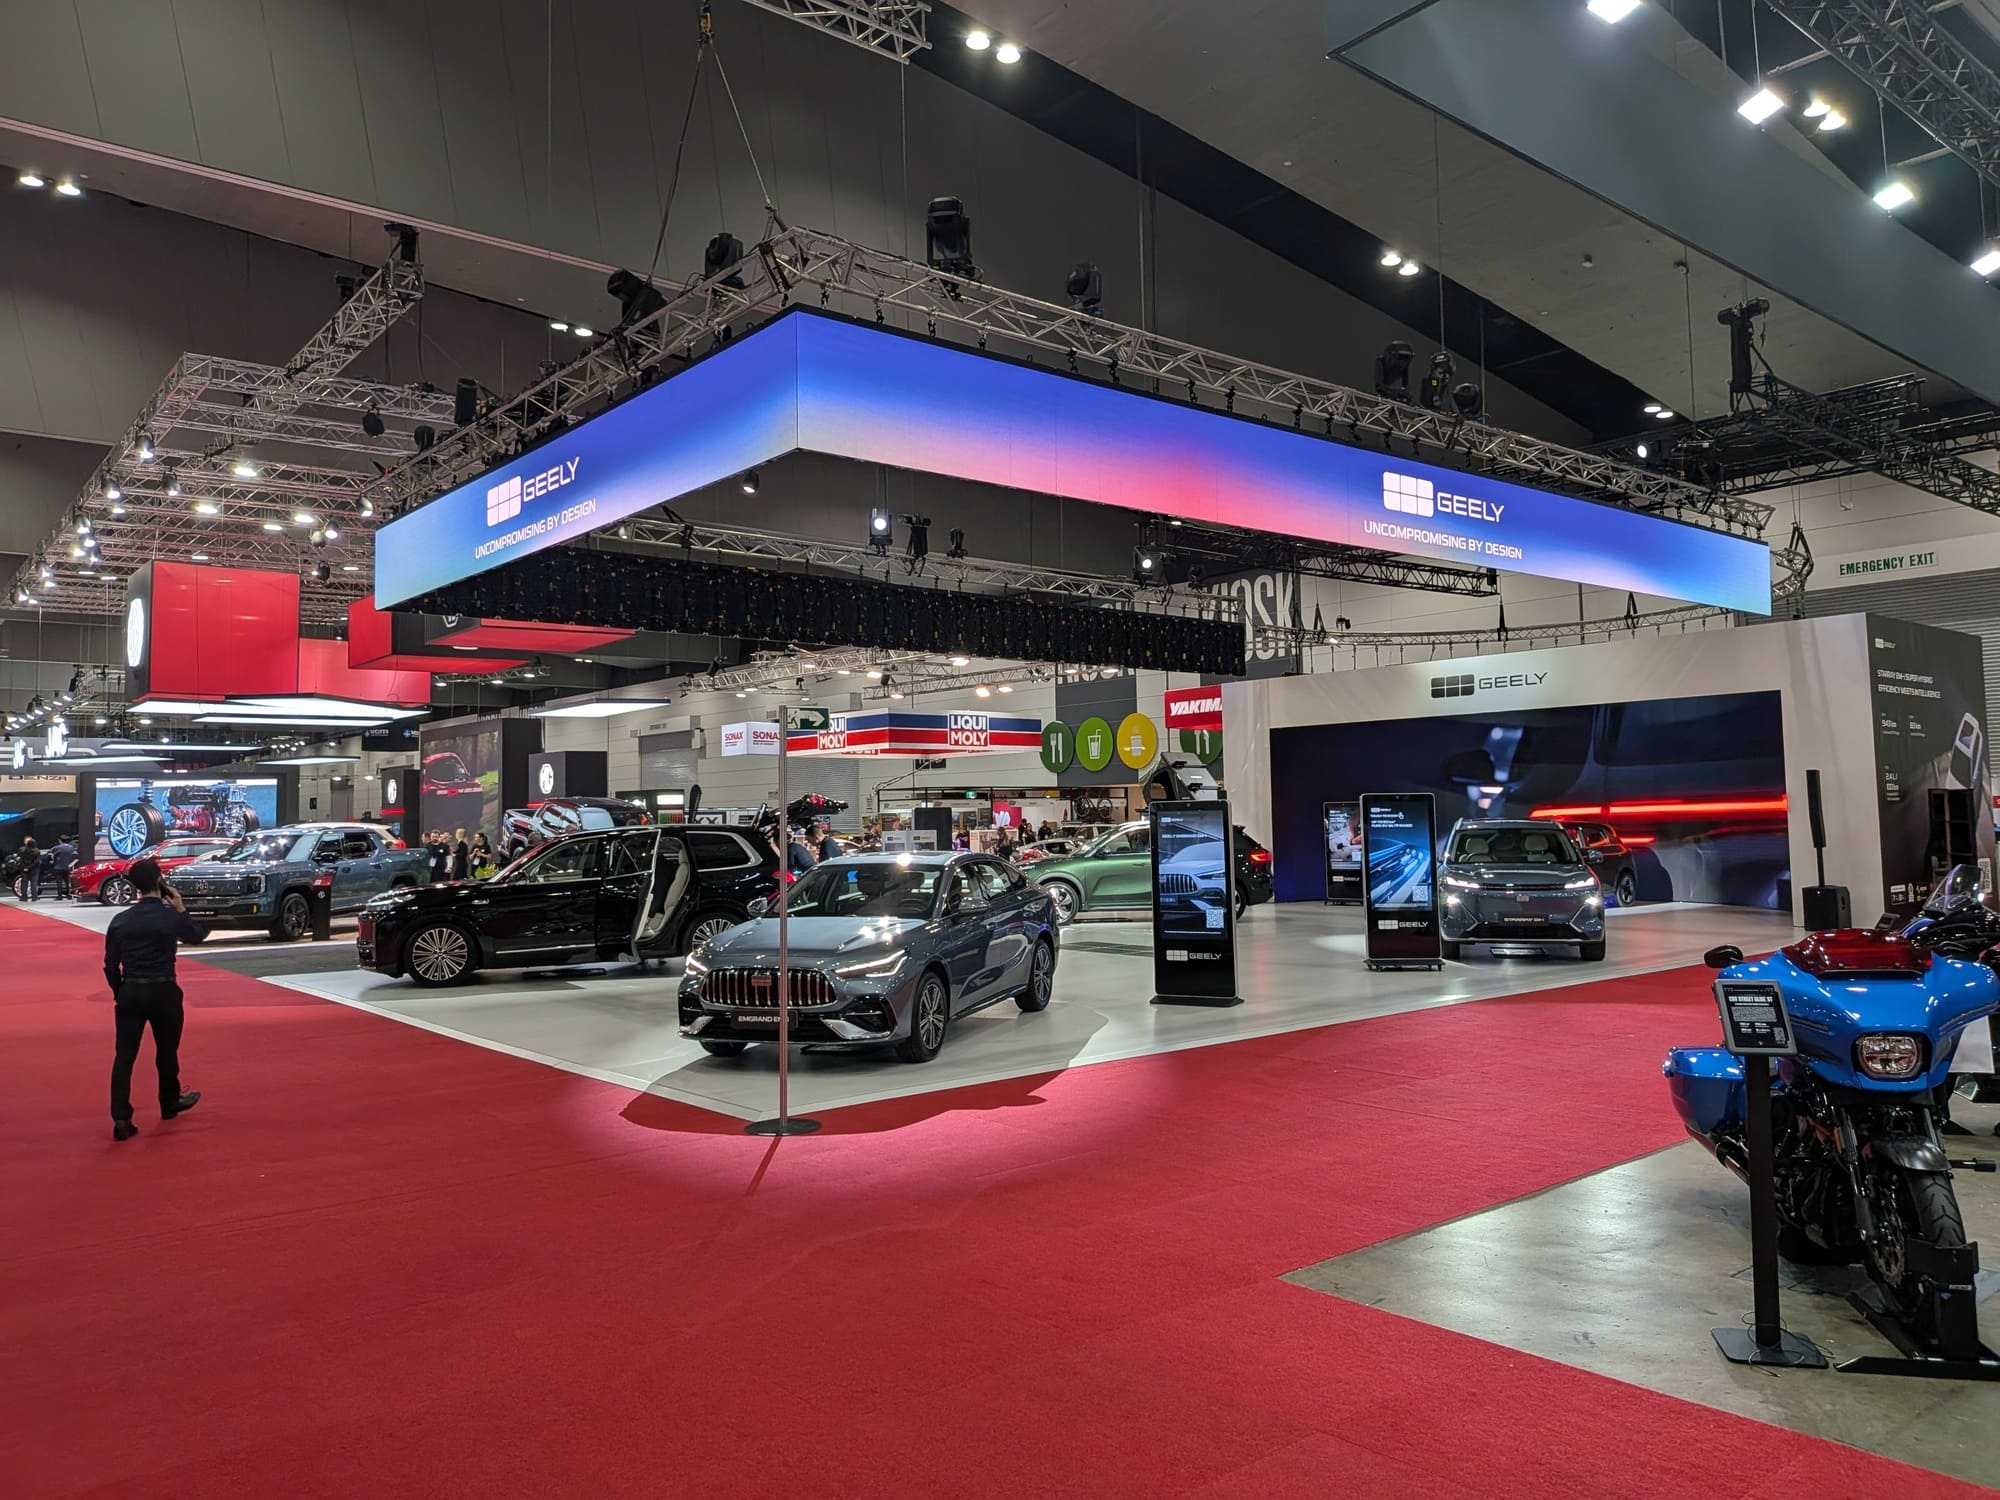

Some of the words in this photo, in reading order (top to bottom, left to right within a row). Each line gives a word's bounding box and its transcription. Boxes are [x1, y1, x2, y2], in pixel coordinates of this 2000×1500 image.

[523, 456, 580, 503] GEELY
[1437, 491, 1505, 522] GEELY
[475, 519, 546, 560] UNCOMPROMISING
[547, 513, 561, 531] BY
[561, 498, 597, 525] DESIGN
[1364, 519, 1467, 549] UNCOMPROMISING
[1468, 538, 1483, 553] BY
[1485, 542, 1523, 560] DESIGN
[1839, 556, 1905, 576] EMERGENCY
[1909, 552, 1935, 567] EXIT
[1478, 672, 1549, 690] GEELY
[1169, 698, 1223, 717] YAKIM
[950, 715, 987, 731] LIQUI
[724, 731, 744, 742] SONAX
[752, 730, 780, 740] SONA
[820, 734, 845, 749] MOLY
[950, 730, 988, 746] MOLY
[1189, 951, 1222, 960] GEELY
[738, 1015, 773, 1023] EMGRAND
